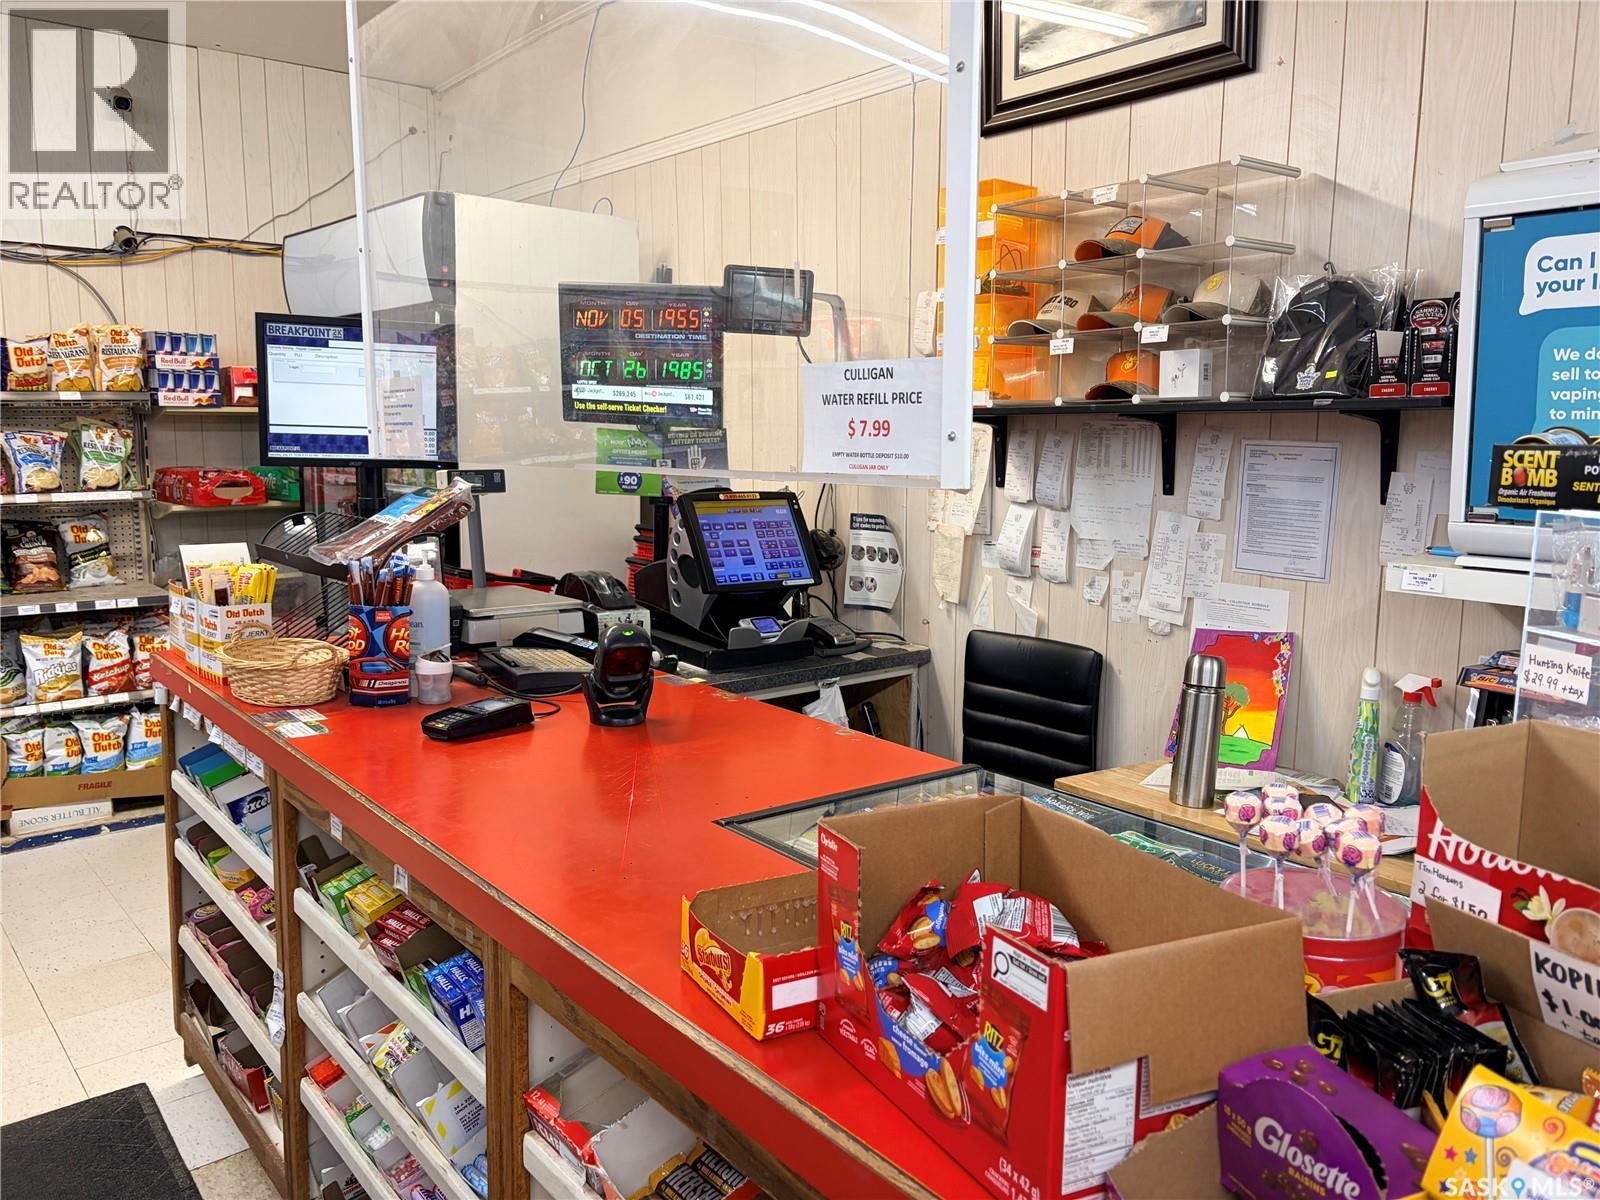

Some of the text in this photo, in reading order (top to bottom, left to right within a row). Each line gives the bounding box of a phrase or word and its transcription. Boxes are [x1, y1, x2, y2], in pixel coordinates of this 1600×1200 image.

[1537, 251, 1596, 273] Can I
[1535, 278, 1586, 299] your
[575, 309, 700, 329] NOV 05 1955
[110, 329, 122, 337] Old
[268, 324, 343, 338] BREAKPOINT 2K
[634, 332, 686, 340] DESTINATION
[55, 339, 78, 348] Dutch
[14, 346, 33, 358] Old
[1553, 347, 1580, 361] We
[161, 357, 187, 365] Red Bull
[578, 360, 704, 381] OCT 26 1985
[843, 367, 894, 381] CULLIGAN
[1552, 367, 1580, 381] sell
[163, 394, 189, 402] Red Bull
[822, 391, 923, 406] WATER REFILL PRICE
[574, 401, 668, 413] Use the self-serve Ticket Checker!
[1549, 408, 1566, 420] to
[1502, 449, 1561, 469] SCENT
[1501, 468, 1558, 488] BOMB
[1498, 486, 1557, 498] Organic Air Freshener
[70, 525, 89, 534] Old
[226, 607, 265, 619] Old Dutch
[138, 635, 155, 644] Old
[245, 629, 270, 639] JERKY
[94, 651, 123, 661] Dutch
[34, 660, 78, 686] Ridgies
[92, 663, 130, 682] Ketchup
[1528, 654, 1591, 680] Hunting Knife
[1523, 669, 1559, 691] $29.99
[64, 737, 80, 749] Old
[91, 732, 111, 743] Old
[25, 740, 41, 754] Old
[93, 742, 122, 754] Dutch
[78, 780, 113, 791] FRAGILE
[1416, 859, 1433, 877] Tim
[1417, 880, 1448, 904] 2 for
[403, 909, 420, 922] HALLS
[387, 918, 405, 930] HALLS
[467, 957, 483, 974] HALLS
[450, 966, 468, 983] HALLS
[434, 973, 453, 992] HALLS
[766, 1021, 785, 1036] 36
[892, 1024, 913, 1046] cheese
[983, 1020, 1005, 1050] RITZ
[1254, 1116, 1361, 1200] Glosette
[1020, 1174, 1030, 1193] 42
[1288, 1166, 1326, 1197] RAISINS
